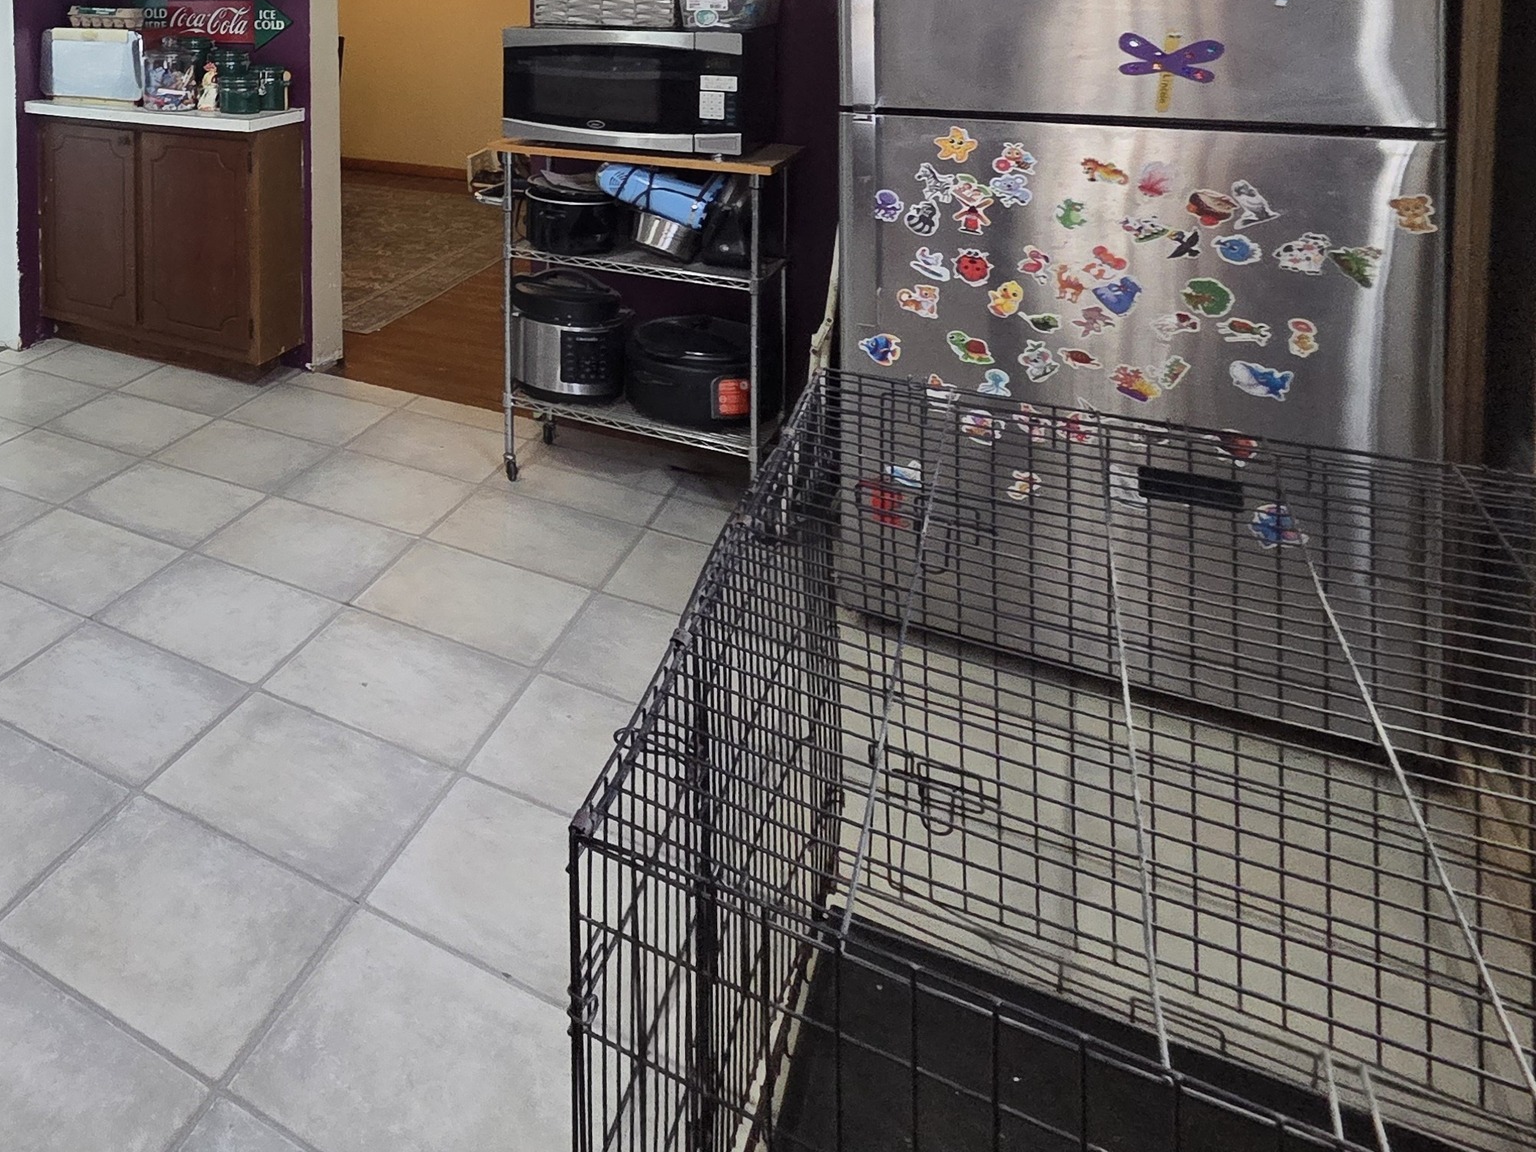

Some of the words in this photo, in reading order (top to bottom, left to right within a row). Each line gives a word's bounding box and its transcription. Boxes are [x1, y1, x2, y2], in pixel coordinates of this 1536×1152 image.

[144, 8, 167, 20] OLD
[259, 9, 277, 20] ICE
[169, 6, 252, 35] Coca-Cola
[253, 19, 285, 31] COLD
